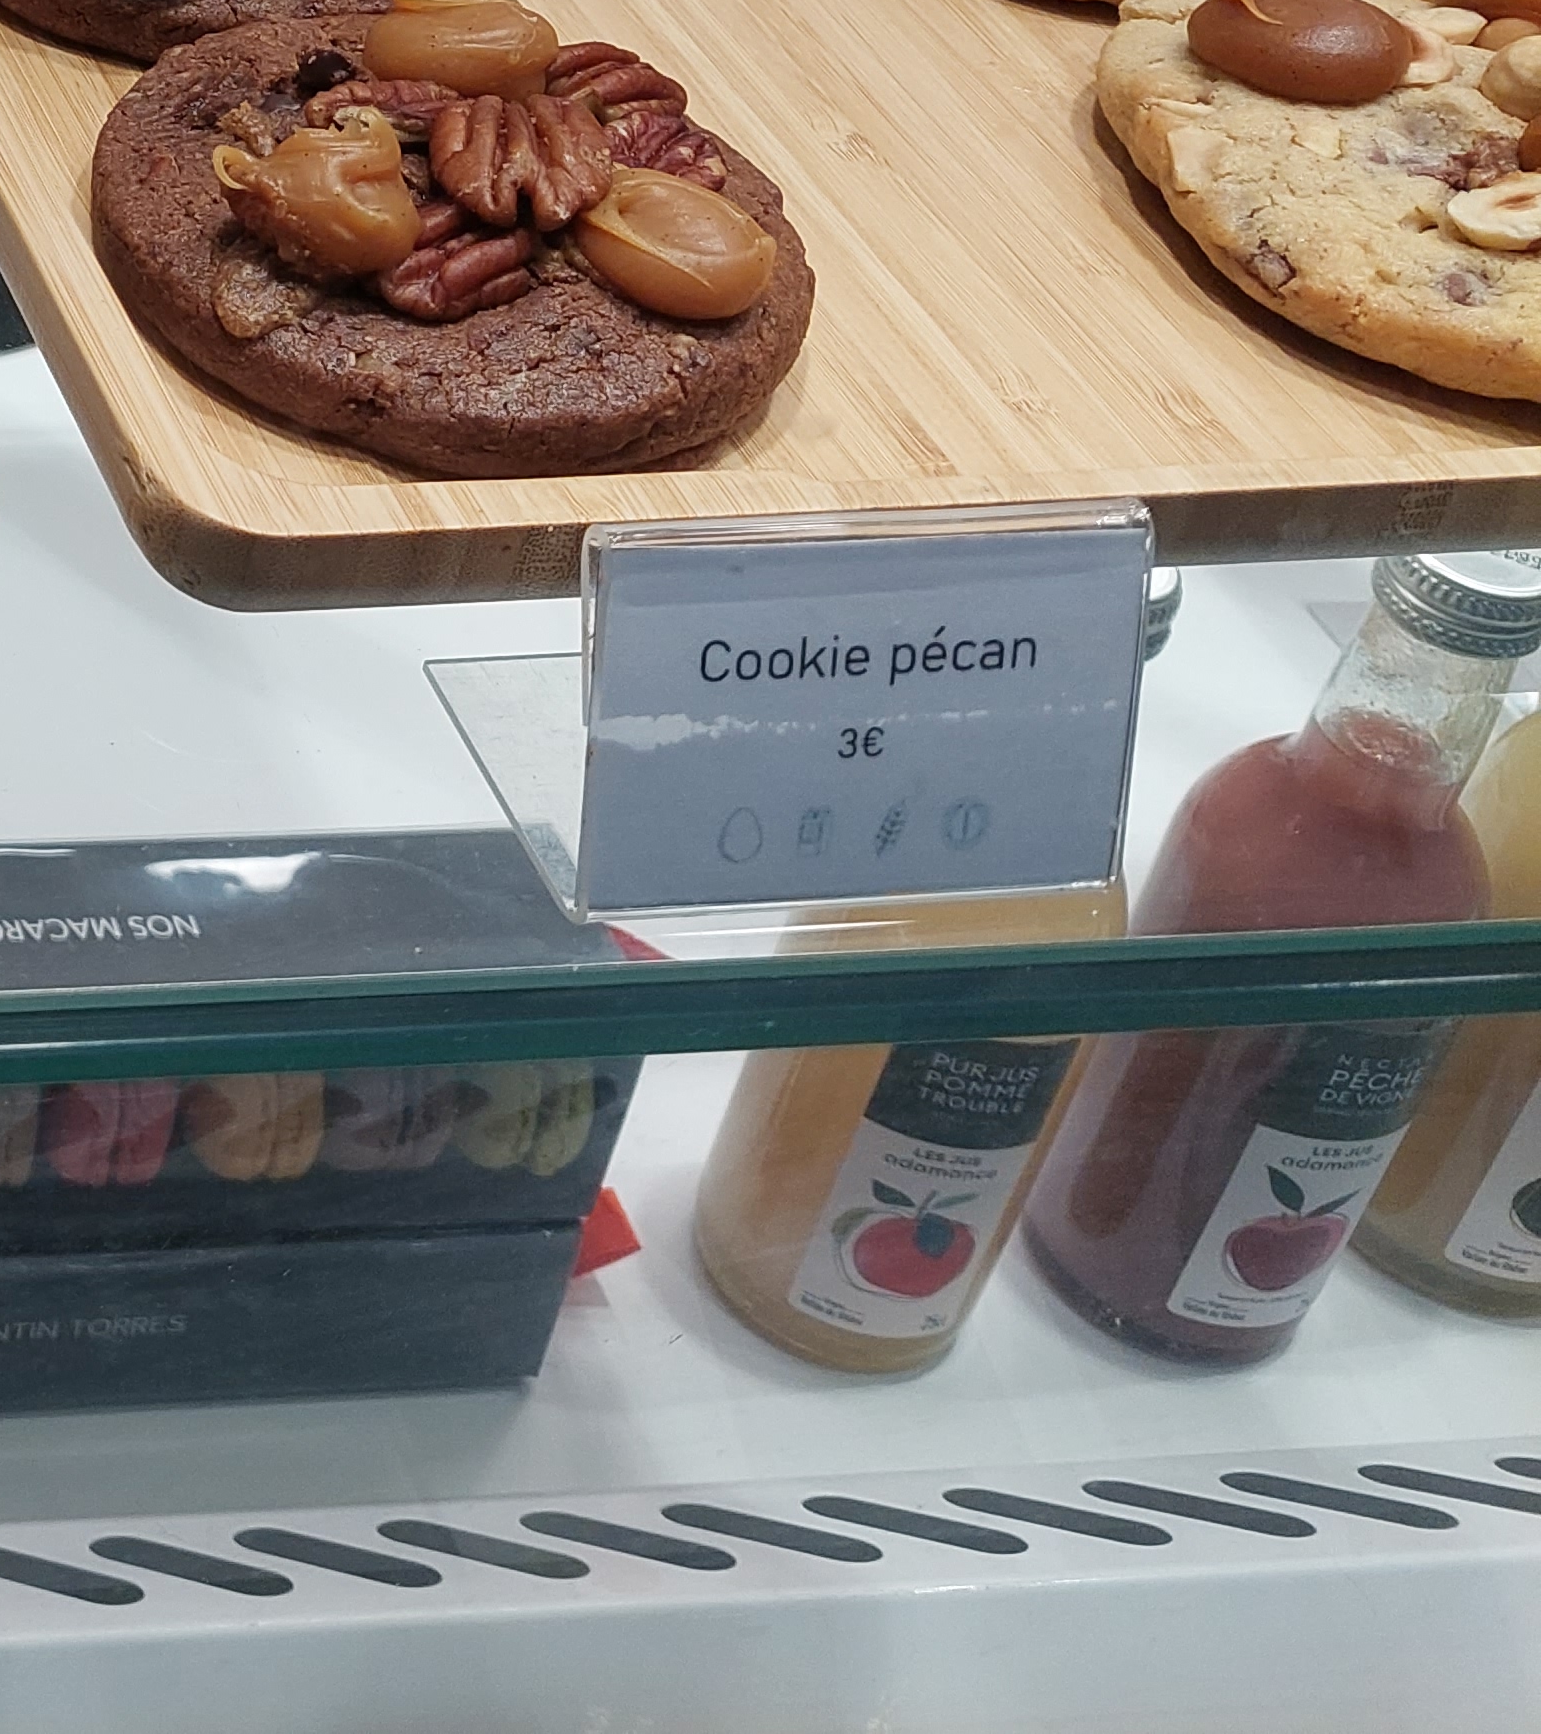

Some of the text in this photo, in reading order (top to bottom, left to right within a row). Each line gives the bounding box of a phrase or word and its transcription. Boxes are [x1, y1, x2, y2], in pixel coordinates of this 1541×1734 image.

[698, 626, 1039, 686] Cookie pécan
[836, 726, 887, 759] 3€
[127, 914, 201, 941] NOS
[932, 1051, 988, 1081] PUR
[1320, 1088, 1352, 1105] DE
[70, 1313, 188, 1340] TORRES
